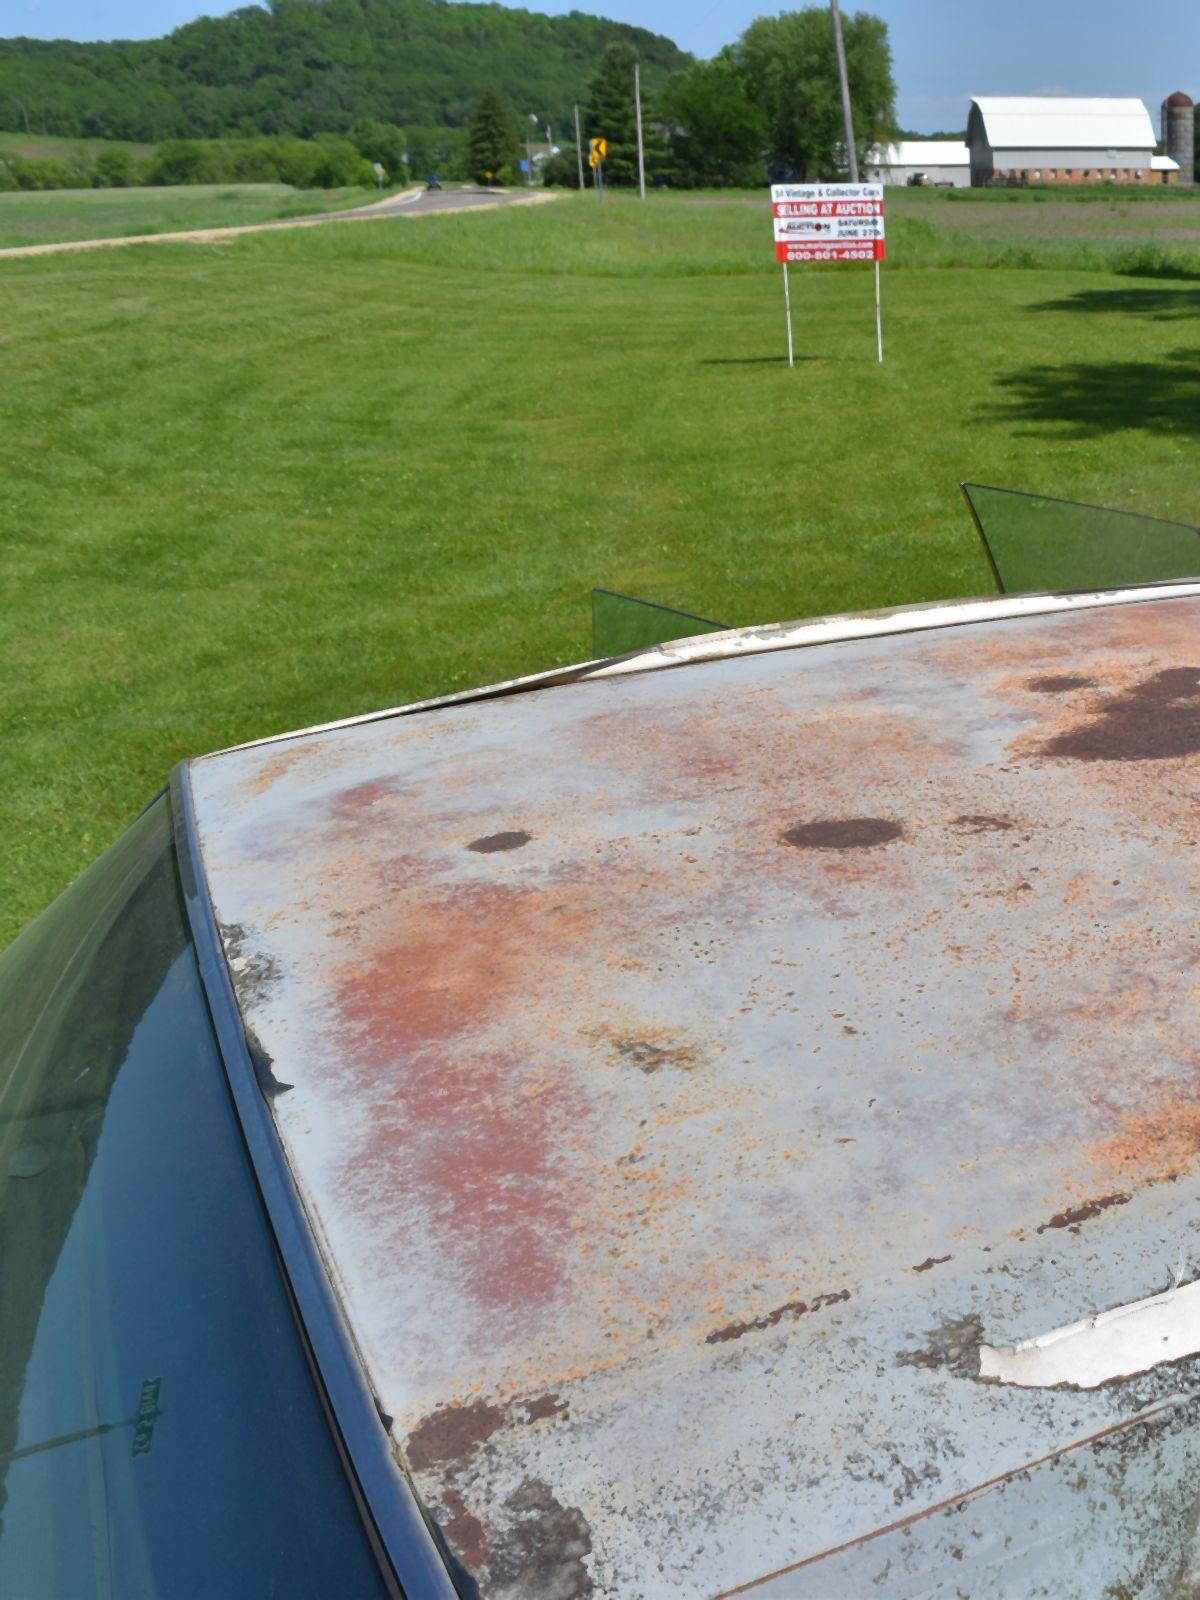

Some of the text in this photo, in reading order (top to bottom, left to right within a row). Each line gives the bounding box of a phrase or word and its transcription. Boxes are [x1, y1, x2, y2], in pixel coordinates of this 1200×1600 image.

[818, 187, 824, 197] &
[826, 187, 860, 196] Collector
[778, 203, 880, 215] SELLING AT AUCTION
[838, 229, 858, 237] JUNE
